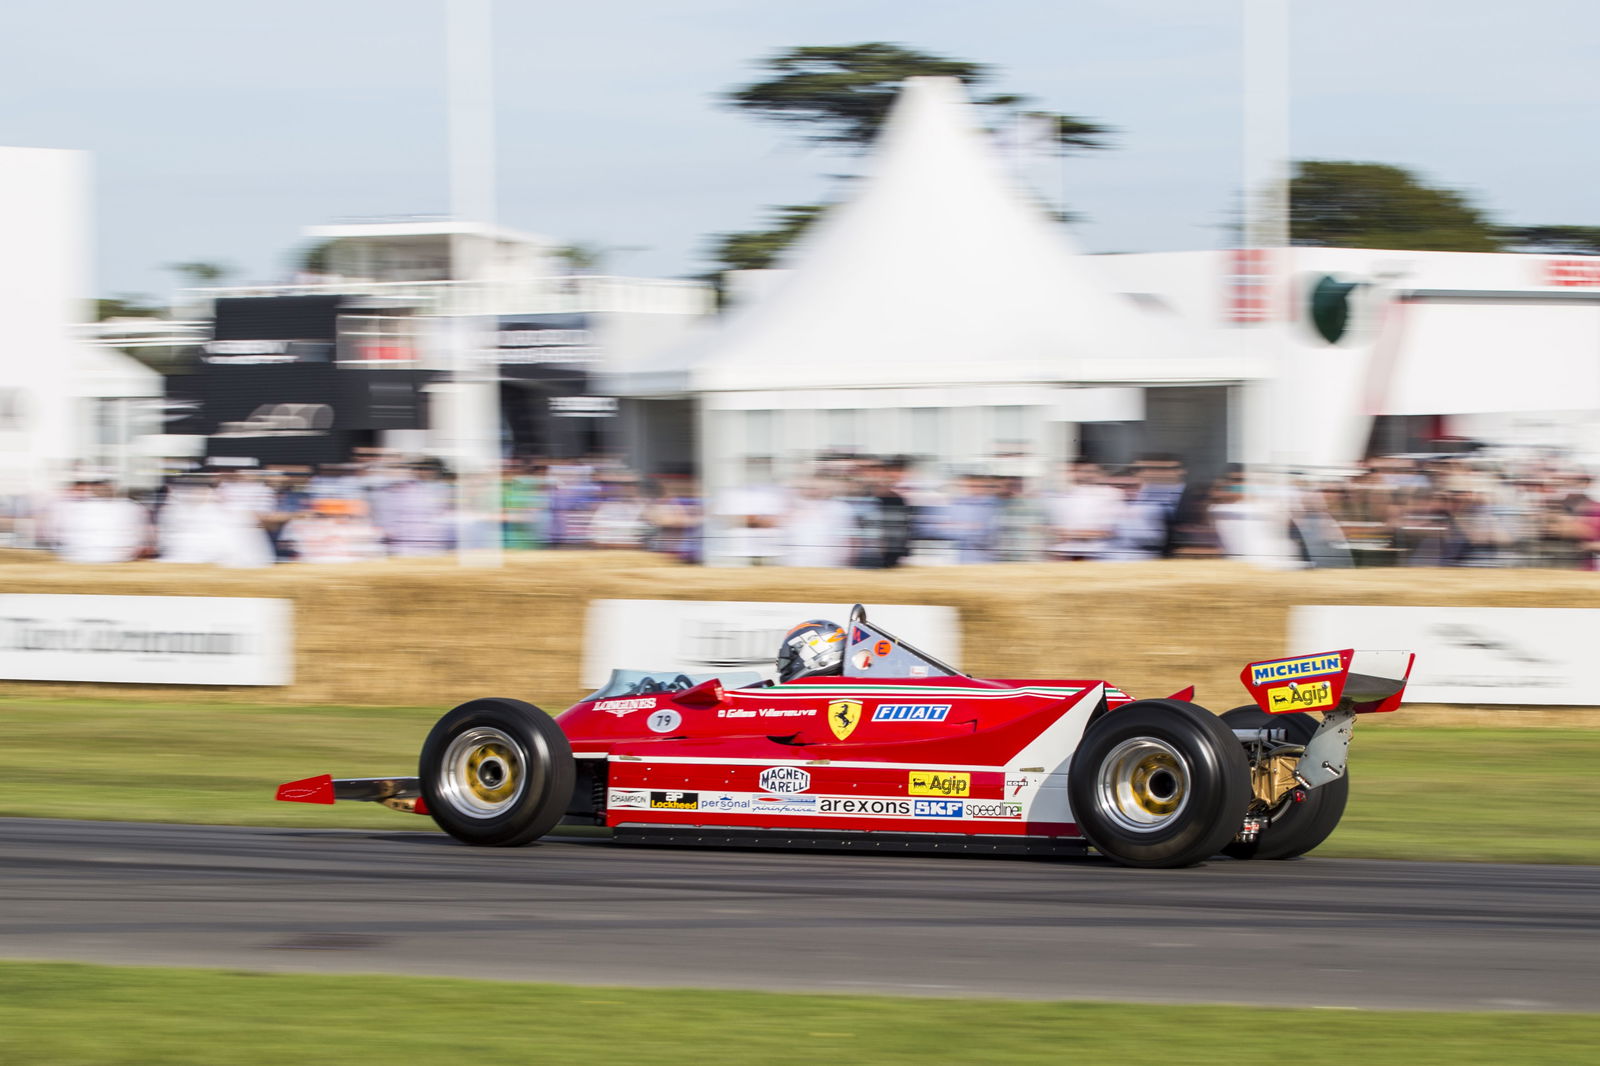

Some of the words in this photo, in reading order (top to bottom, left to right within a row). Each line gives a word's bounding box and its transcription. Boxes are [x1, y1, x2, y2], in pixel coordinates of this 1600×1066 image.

[1254, 657, 1340, 680] MICHELIN
[1291, 685, 1329, 705] Agip
[592, 698, 656, 711] LONGINES
[876, 706, 949, 720] FIAT
[657, 715, 671, 727] 79
[761, 768, 808, 785] MAGNETI
[761, 776, 808, 793] MARELLI
[929, 775, 967, 794] Agip
[610, 794, 646, 803] CHAMPION
[651, 800, 697, 809] Lockheed
[701, 799, 750, 808] personal
[820, 799, 910, 814] arexons
[915, 802, 962, 815] SKF
[966, 802, 1018, 816] speedline
